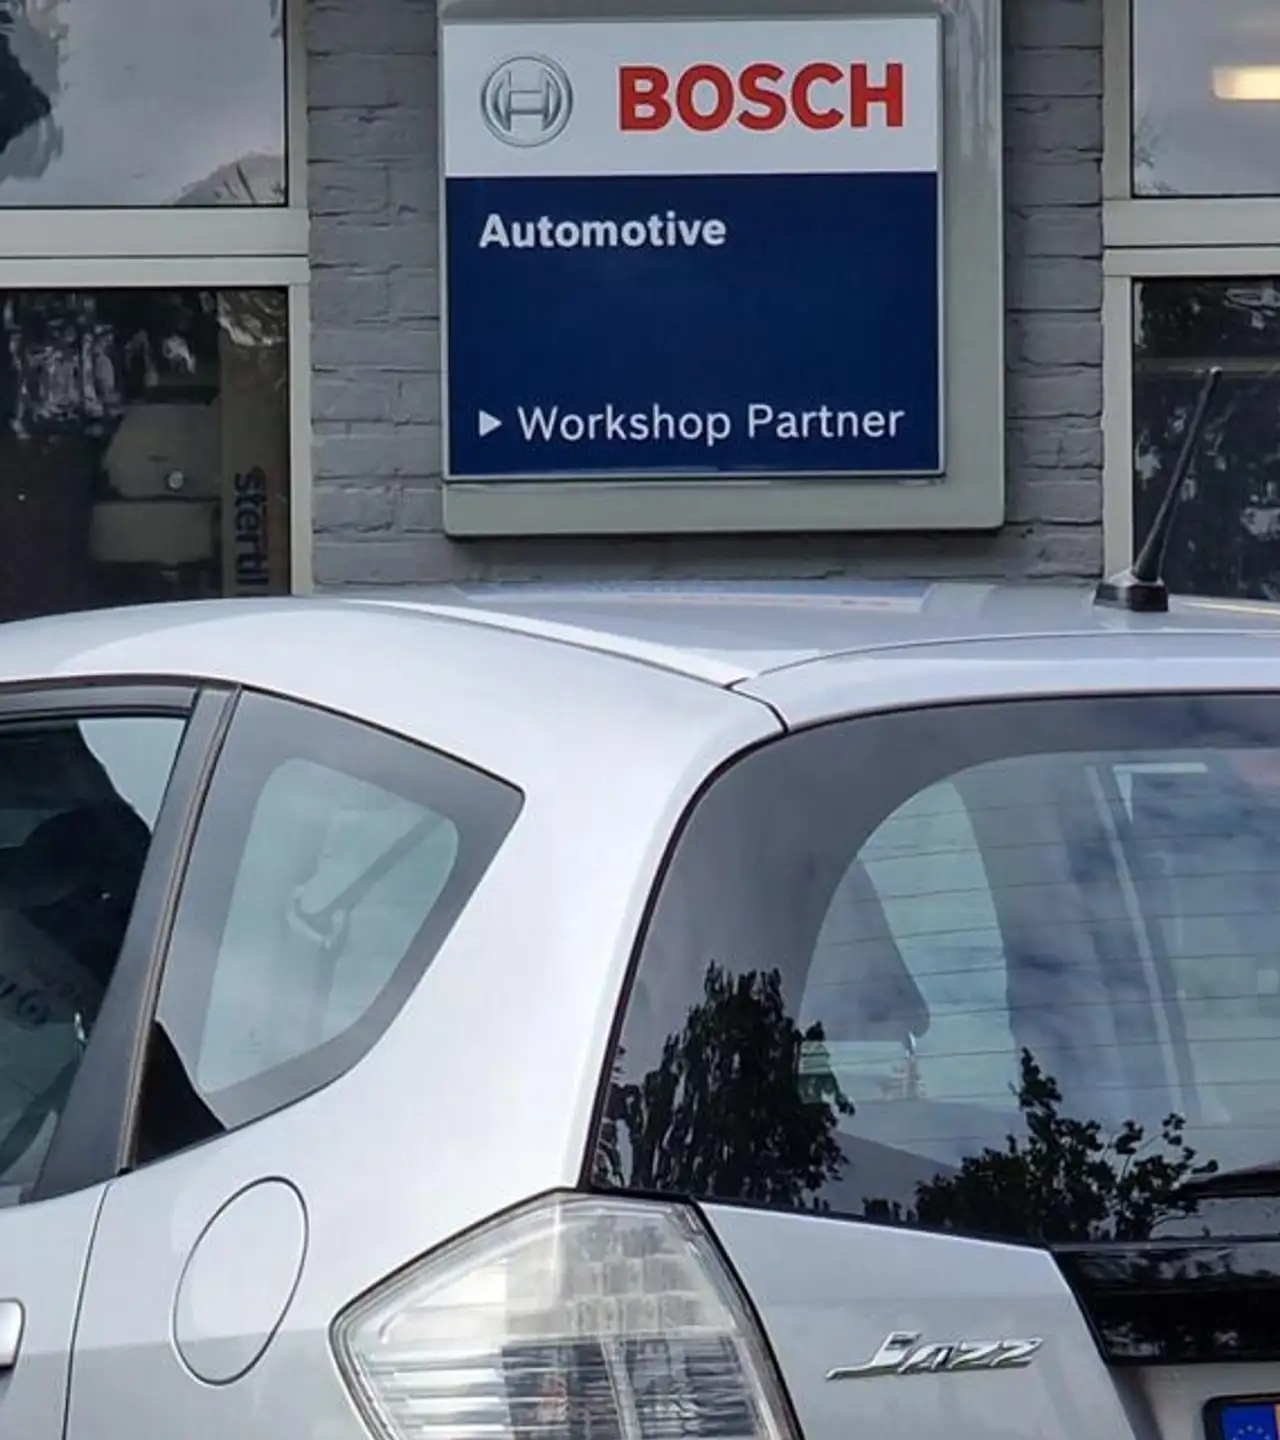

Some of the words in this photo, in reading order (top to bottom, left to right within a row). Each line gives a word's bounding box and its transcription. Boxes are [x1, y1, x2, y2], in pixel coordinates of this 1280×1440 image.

[619, 62, 904, 132] BOSCH
[479, 211, 727, 248] Automotive
[517, 404, 732, 446] Workshop
[747, 404, 905, 440] Partner
